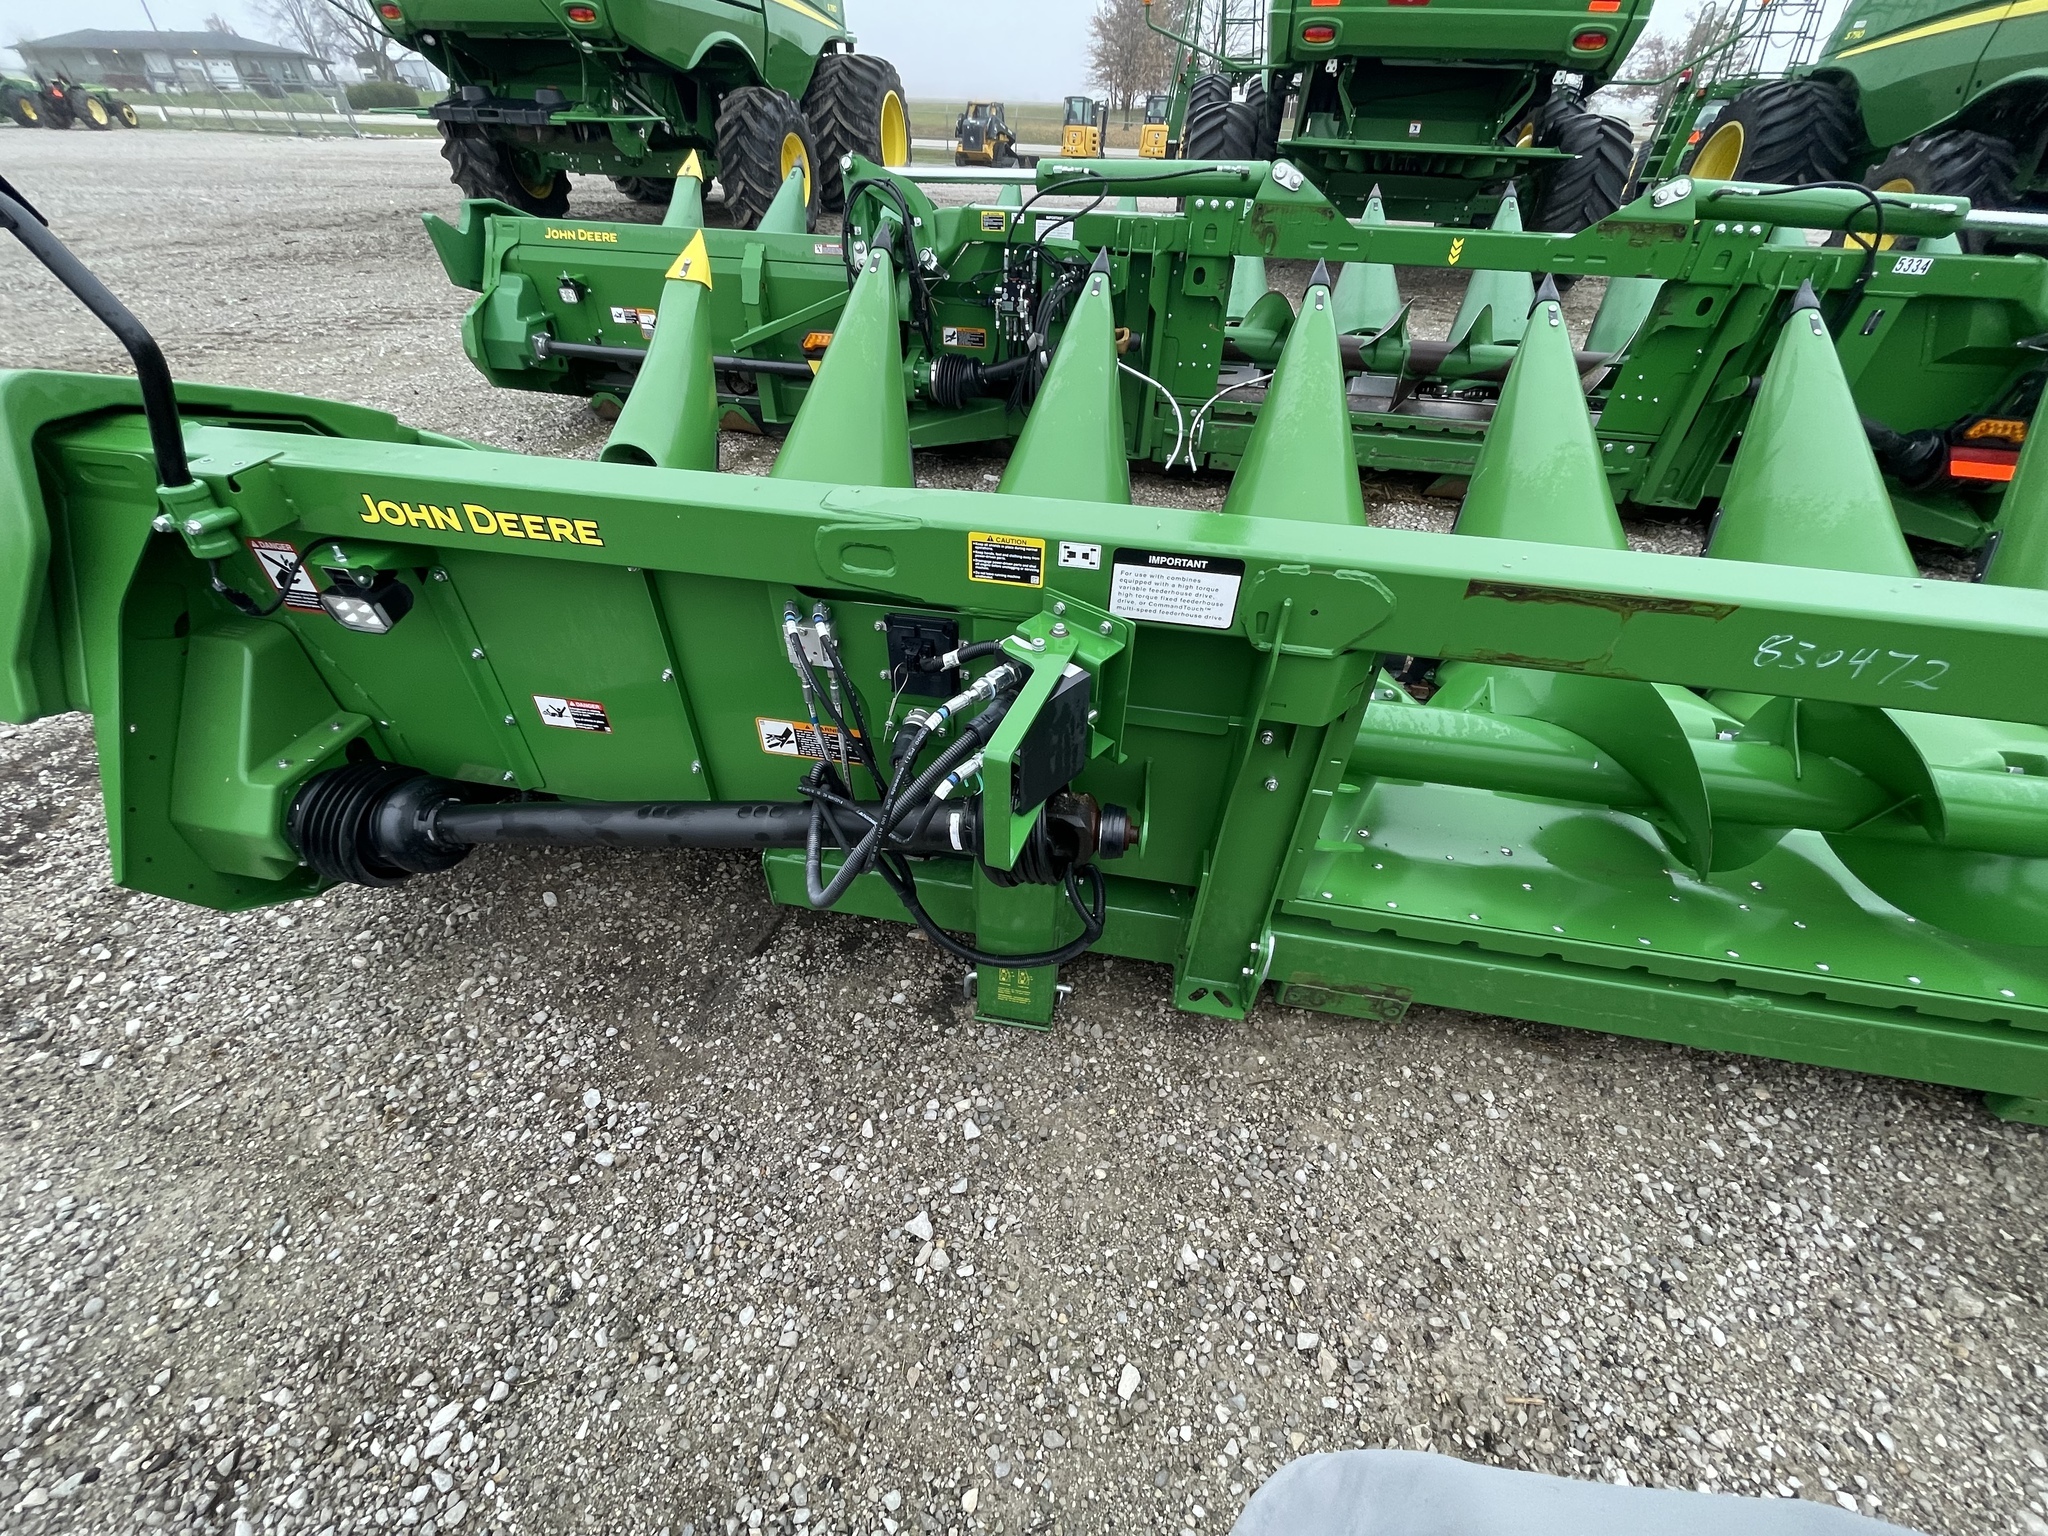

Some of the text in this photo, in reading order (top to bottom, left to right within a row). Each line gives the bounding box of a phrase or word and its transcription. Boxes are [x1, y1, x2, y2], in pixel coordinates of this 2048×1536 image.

[545, 227, 617, 242] JOHN DEERE
[1895, 258, 1931, 273] 5334
[359, 493, 605, 547] JOHN DEERE
[258, 541, 294, 551] DANGER
[996, 537, 1026, 545] CAUTION
[1149, 556, 1208, 568] IMPORTANT
[1149, 588, 1192, 597] feederhouse
[1180, 598, 1224, 607] feederhouse
[1159, 610, 1202, 618] feederhouse
[1754, 634, 1950, 690] 830472
[575, 702, 602, 710] DANGER
